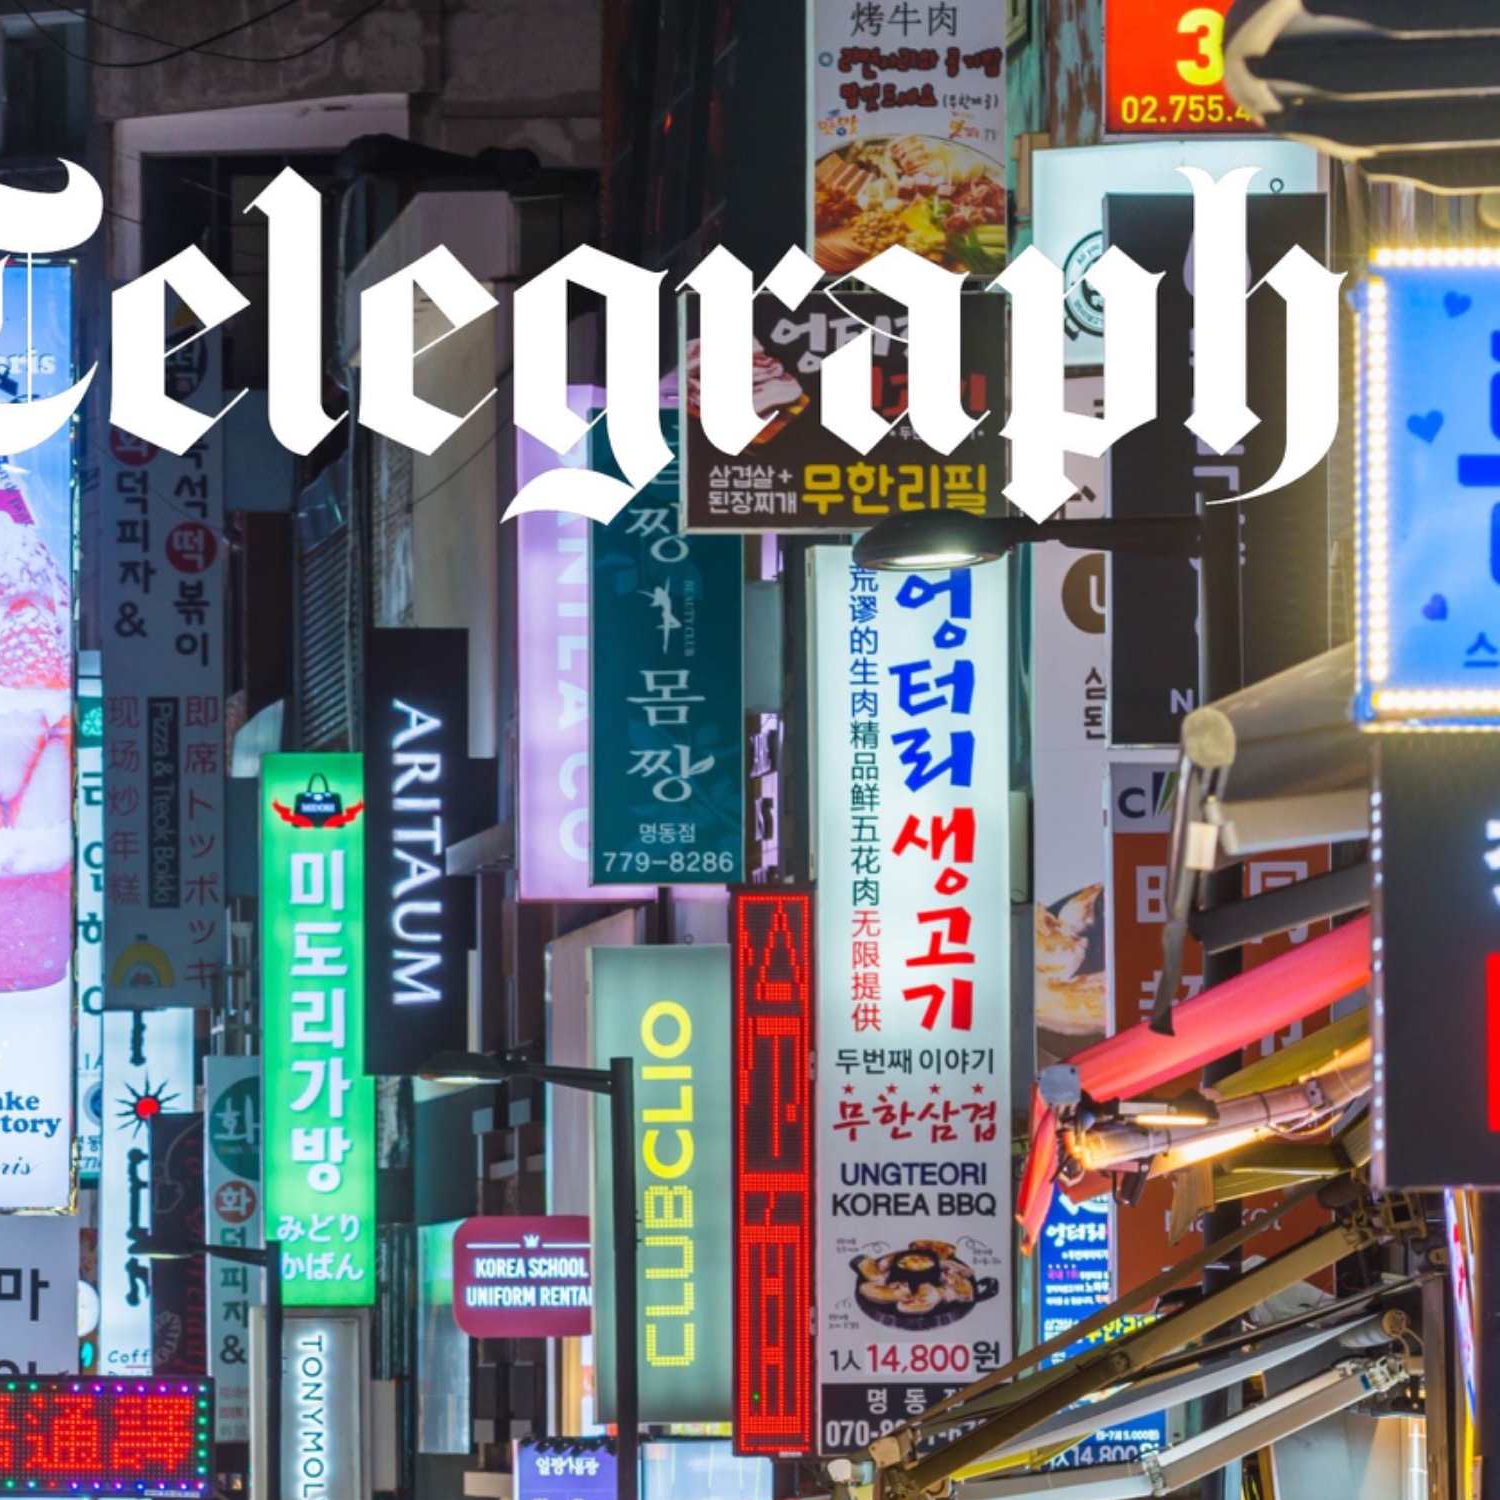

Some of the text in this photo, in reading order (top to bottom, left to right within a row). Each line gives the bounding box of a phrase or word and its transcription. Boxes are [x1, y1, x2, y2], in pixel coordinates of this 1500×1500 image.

[850, 2, 957, 37] 烤牛肉
[708, 491, 798, 515] 된장찌개
[802, 462, 987, 516] 무한리필
[626, 669, 715, 803] 몸짱
[638, 822, 697, 844] 명동점
[392, 696, 442, 1005] ARITAUM
[602, 851, 735, 874] 779-8286
[289, 849, 352, 1194] 미도리가방
[835, 1048, 995, 1075] 두번째 이야기
[832, 1096, 997, 1144] 무한삼겹
[840, 1162, 988, 1188] UNGTEORI
[832, 1193, 997, 1219] KOREA BBQ
[276, 1214, 361, 1243] みどり
[281, 1252, 365, 1283] かばん
[475, 1257, 589, 1279] KOREA SCHOOL
[466, 1286, 536, 1307] UNIFORM
